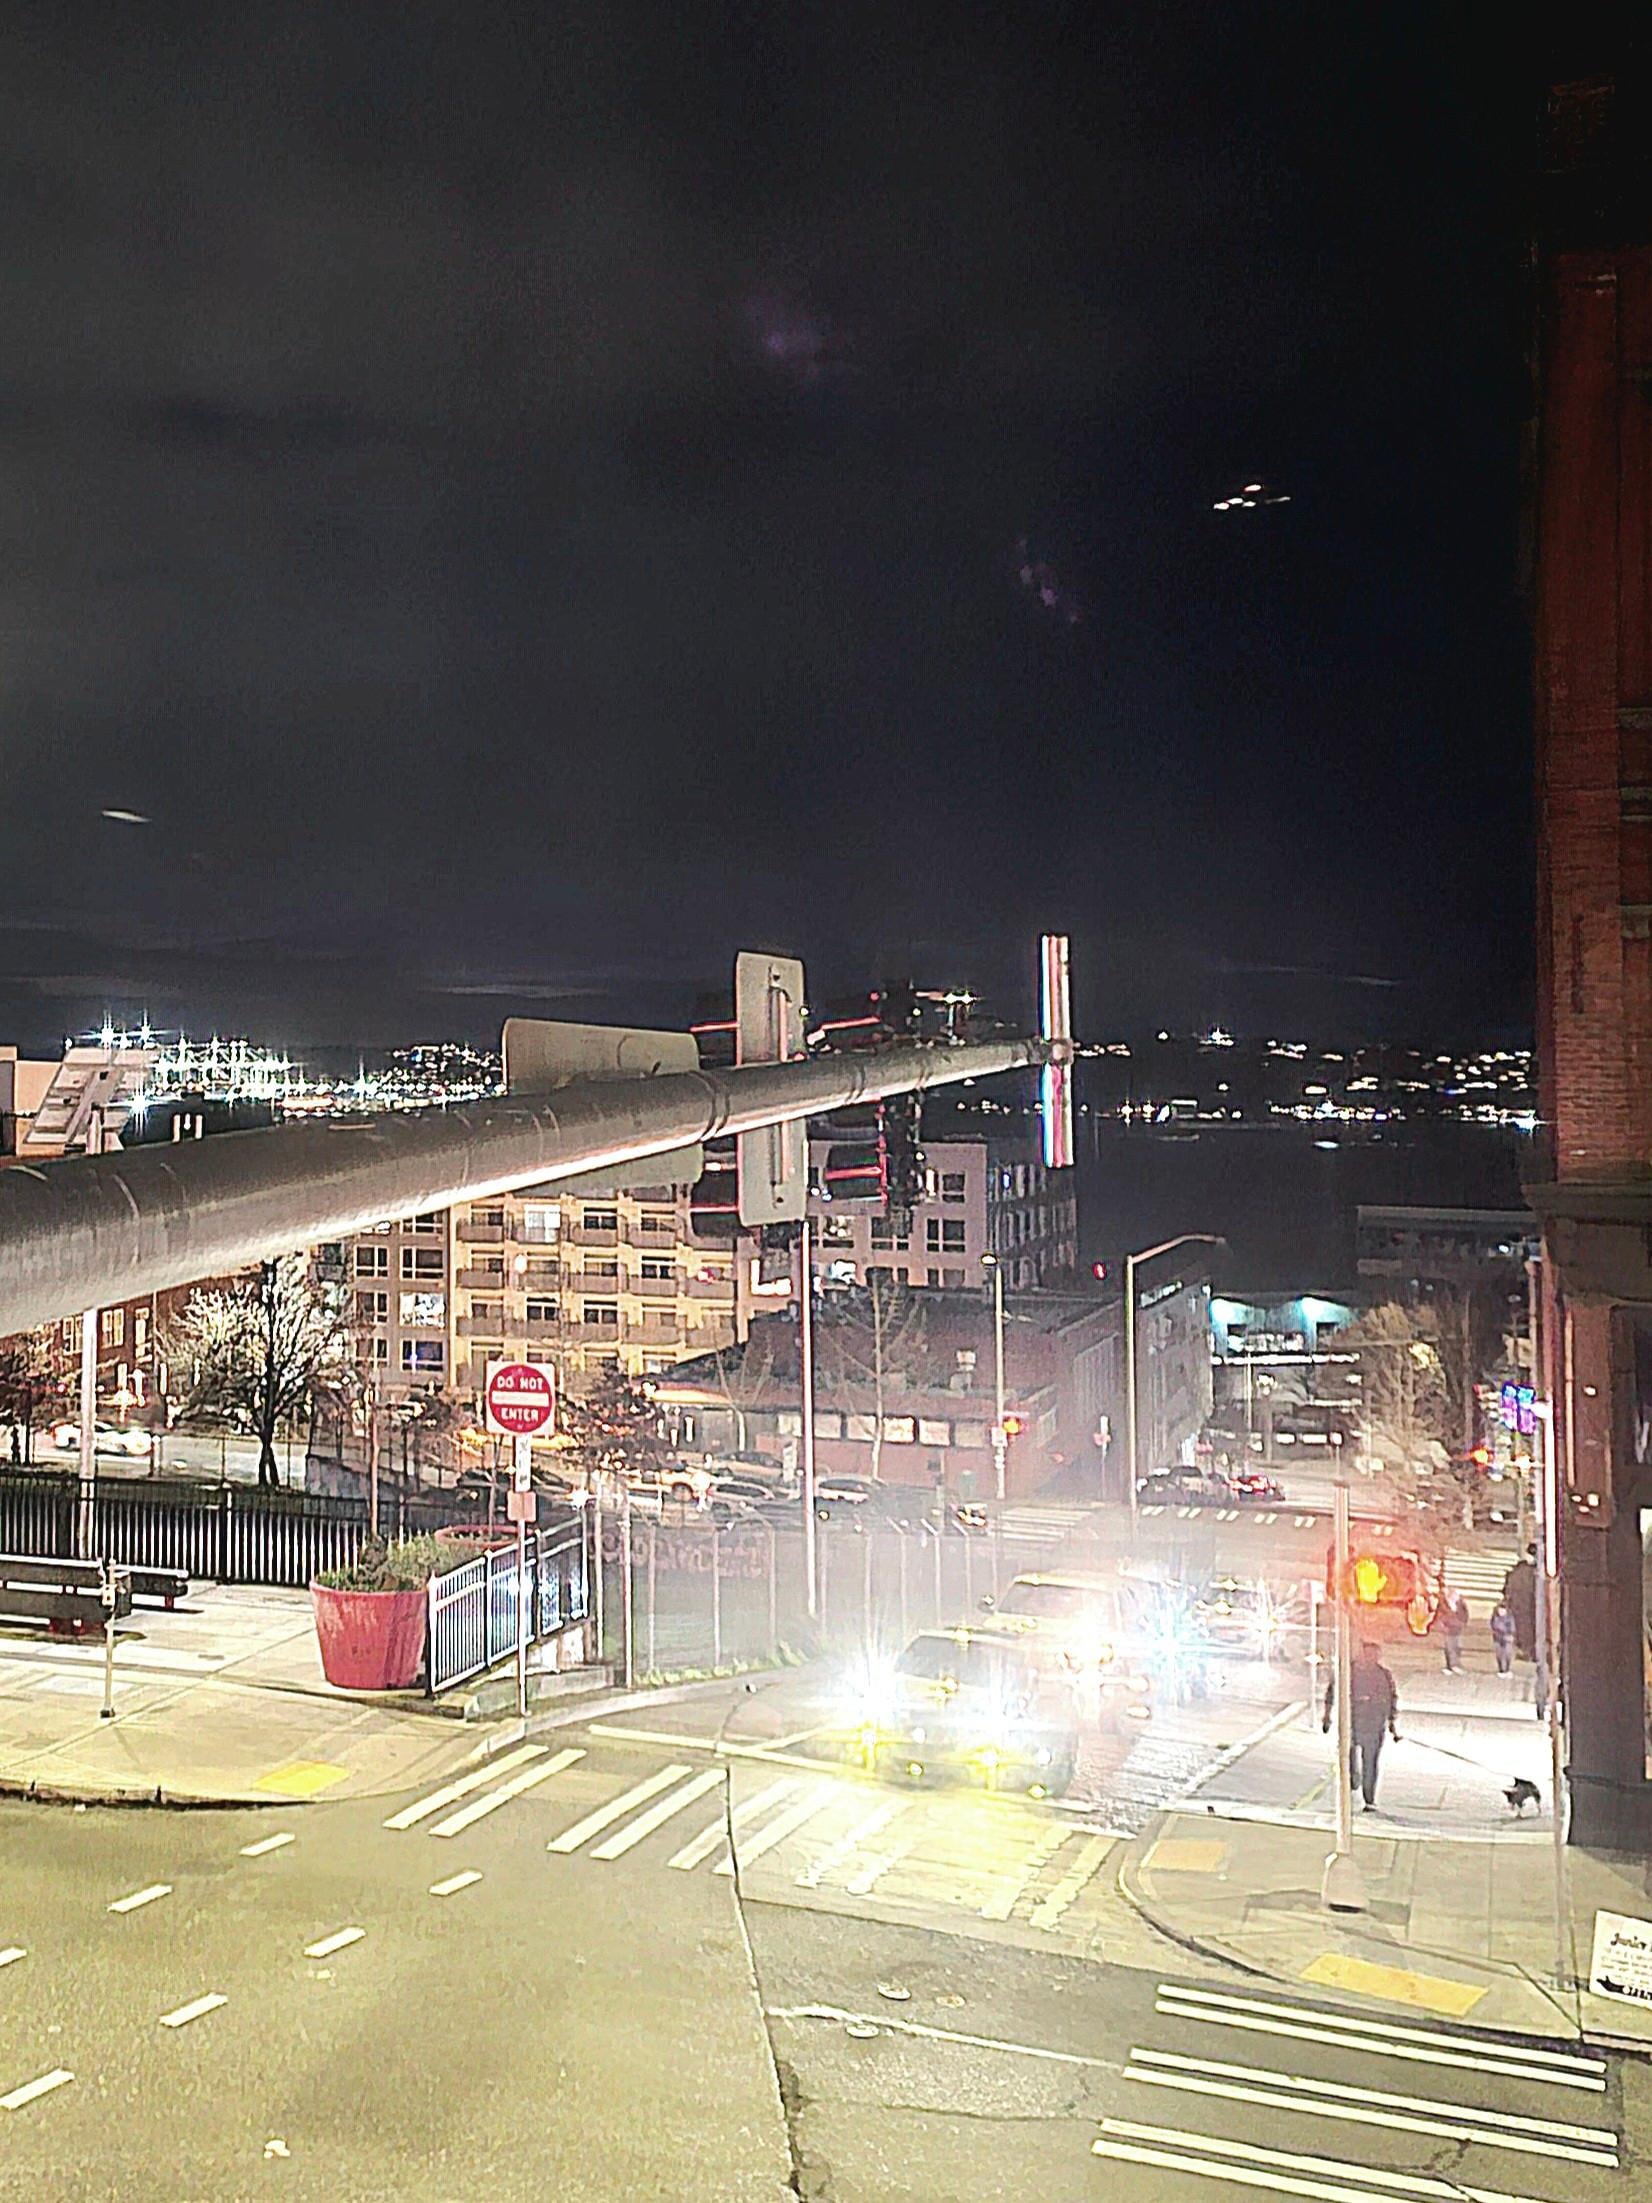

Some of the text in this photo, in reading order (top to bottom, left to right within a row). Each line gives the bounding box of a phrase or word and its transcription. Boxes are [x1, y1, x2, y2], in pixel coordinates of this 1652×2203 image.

[497, 1376, 543, 1391] DO NOT
[501, 1407, 539, 1422] ENTER
